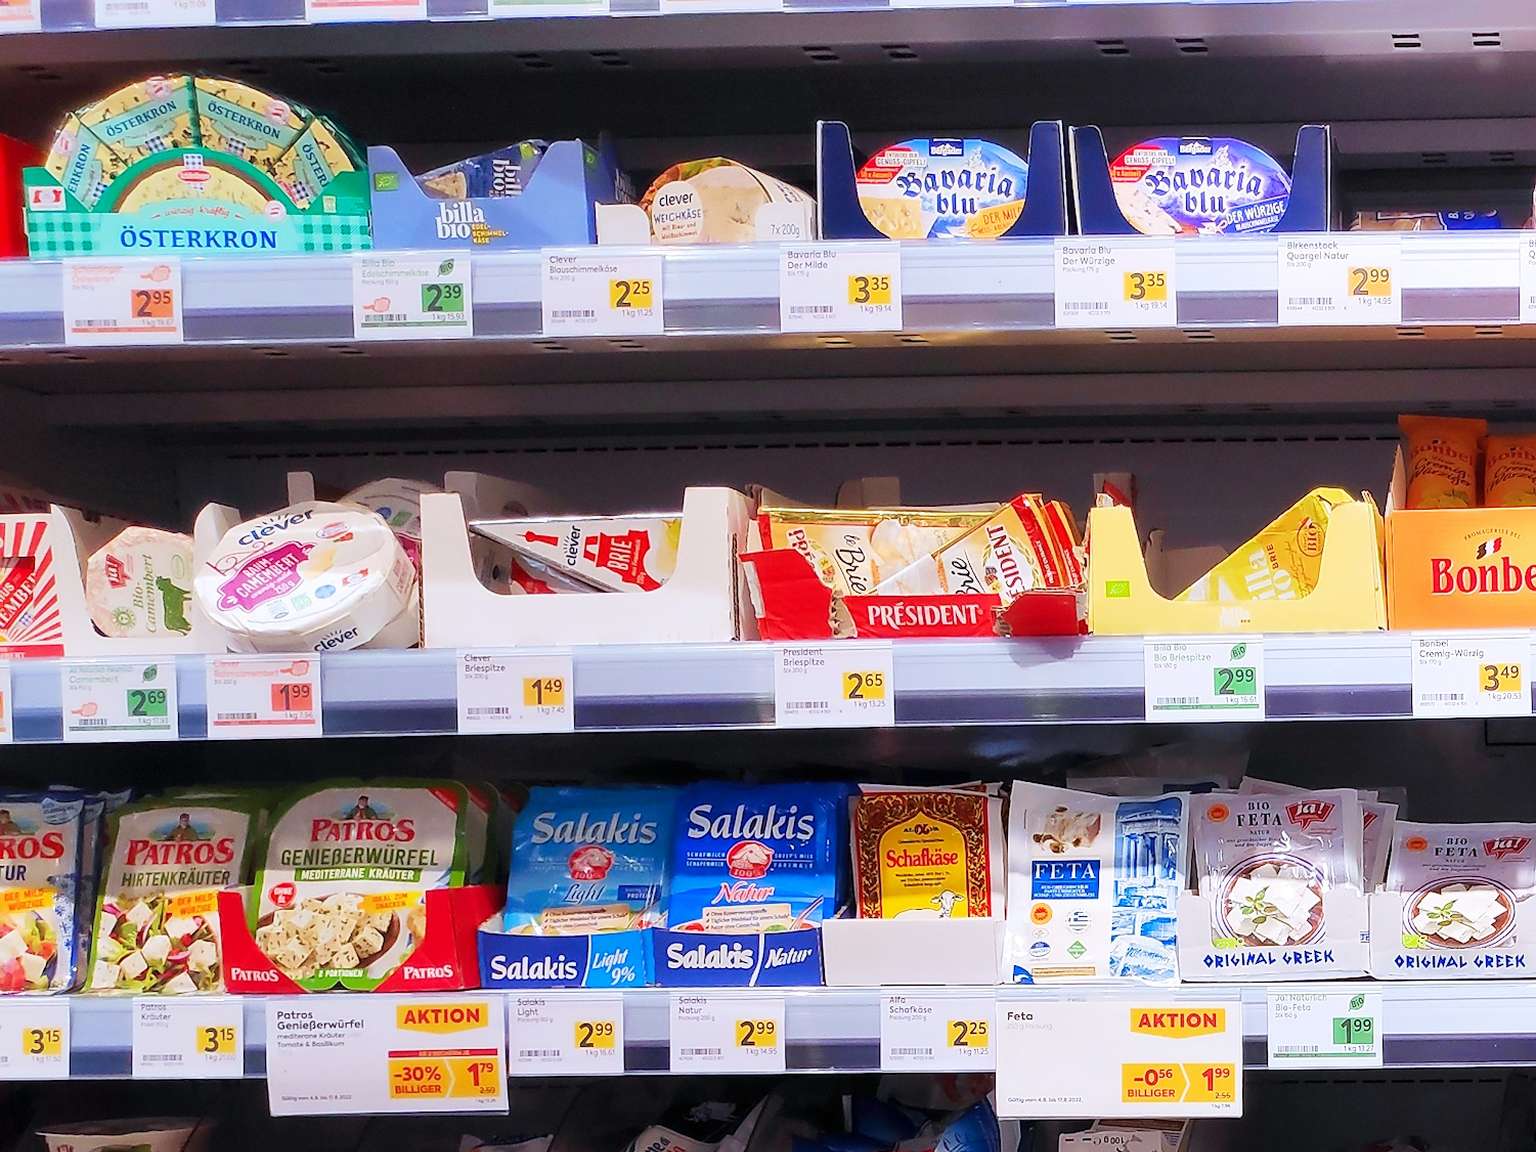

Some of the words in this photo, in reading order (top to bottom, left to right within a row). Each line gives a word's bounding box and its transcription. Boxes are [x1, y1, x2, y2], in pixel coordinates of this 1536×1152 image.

[106, 101, 177, 137] ÖSTERKRON
[896, 167, 1013, 198] Bavaria
[1145, 164, 1262, 196] Bavaria
[659, 191, 693, 206] clever
[937, 192, 978, 215] blu
[439, 202, 484, 224] billa
[120, 226, 277, 248] ÖSTERKRON
[437, 219, 470, 240] bio
[549, 254, 577, 264] Clever
[803, 260, 828, 269] Milde
[608, 541, 629, 570] BRIE
[868, 602, 979, 629] PRÉSIDENT
[531, 812, 657, 844] Salakis
[1237, 812, 1282, 828] FETA
[310, 819, 416, 842] PATROS
[125, 838, 235, 866] PATROS
[886, 848, 958, 868] Schafkäse
[1435, 846, 1478, 858] FETA
[121, 868, 230, 888] HIRTENKRÄUTER
[1034, 862, 1097, 880] FETA
[564, 884, 604, 903] Light
[667, 944, 753, 969] Salakis
[765, 947, 812, 968] Natur
[1203, 953, 1276, 968] ORIGINAL
[1283, 950, 1335, 965] GREEK
[1395, 955, 1467, 969] ORIGINAL
[1475, 953, 1526, 968] GREEK
[491, 955, 577, 981] Salakis
[277, 1010, 313, 1020] Patros
[404, 1008, 481, 1025] AKTION
[517, 1007, 539, 1018] Light
[1006, 1011, 1033, 1022] Feta
[1138, 1013, 1217, 1028] AKTION
[395, 1085, 441, 1094] BILLIGER
[1127, 1088, 1176, 1098] BILLIGER
